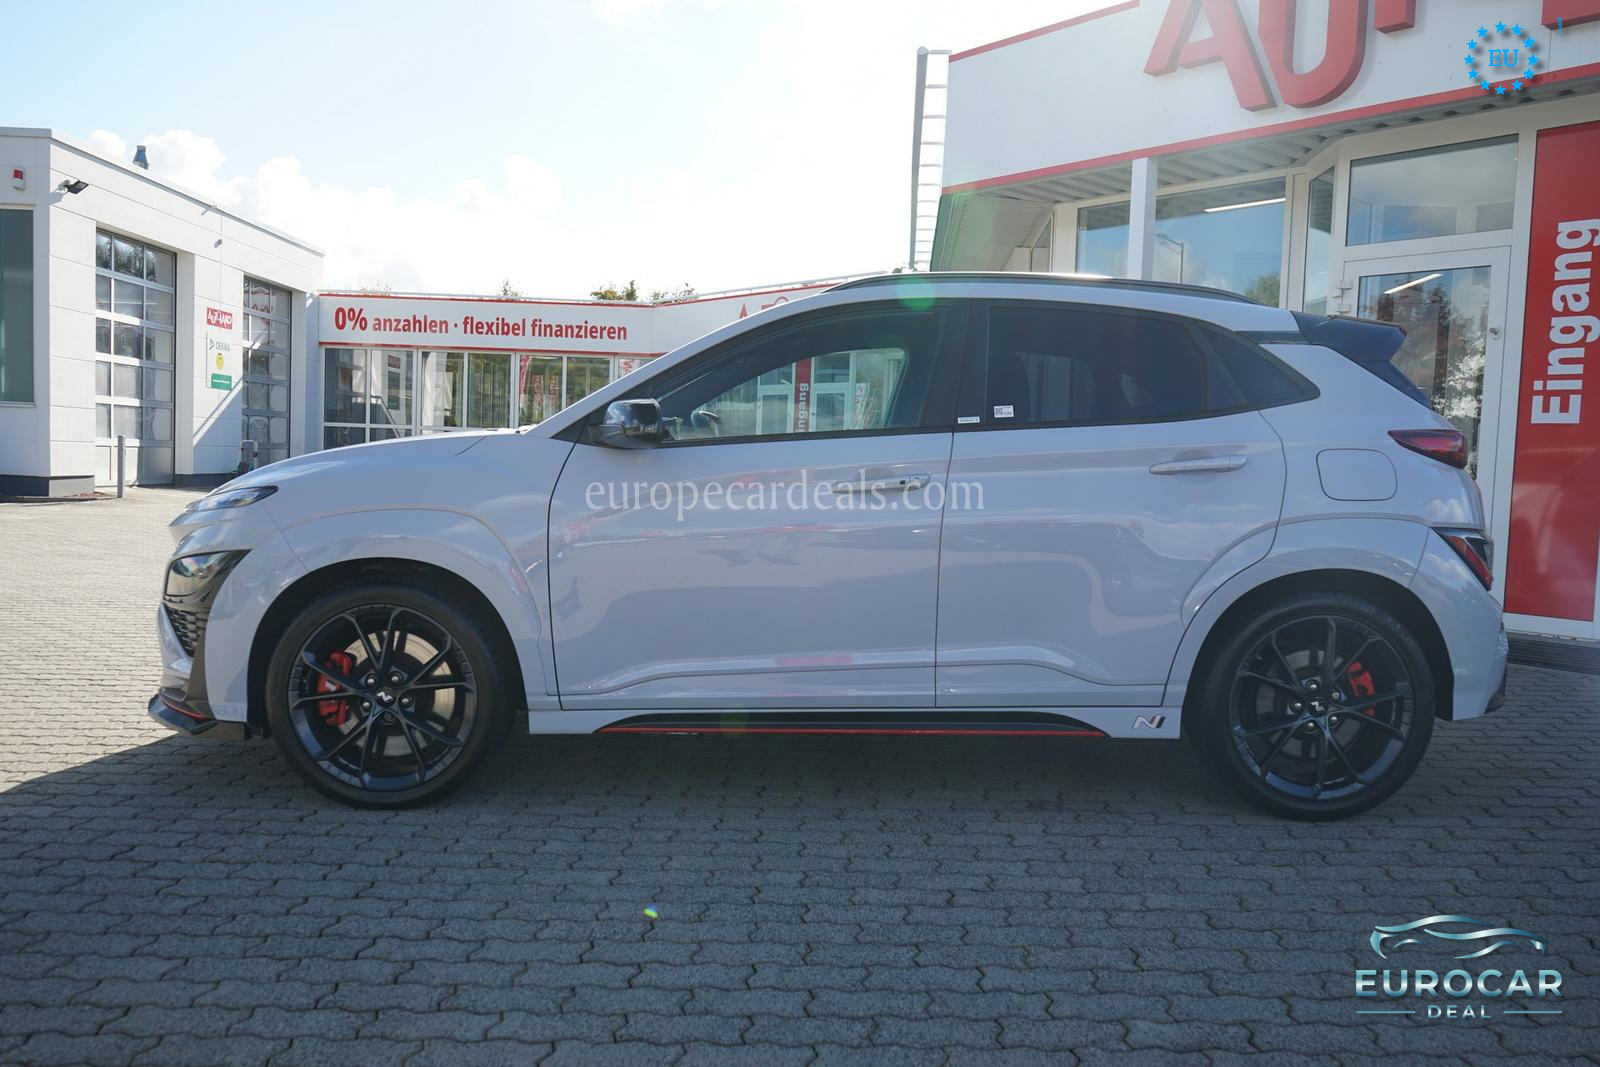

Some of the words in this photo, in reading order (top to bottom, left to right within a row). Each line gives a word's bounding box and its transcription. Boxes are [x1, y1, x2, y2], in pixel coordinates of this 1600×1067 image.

[334, 306, 368, 332] 0%
[372, 314, 449, 334] anzahlen
[462, 316, 527, 337] flexibel
[530, 318, 628, 340] finanzieren
[1530, 218, 1600, 425] Eingang
